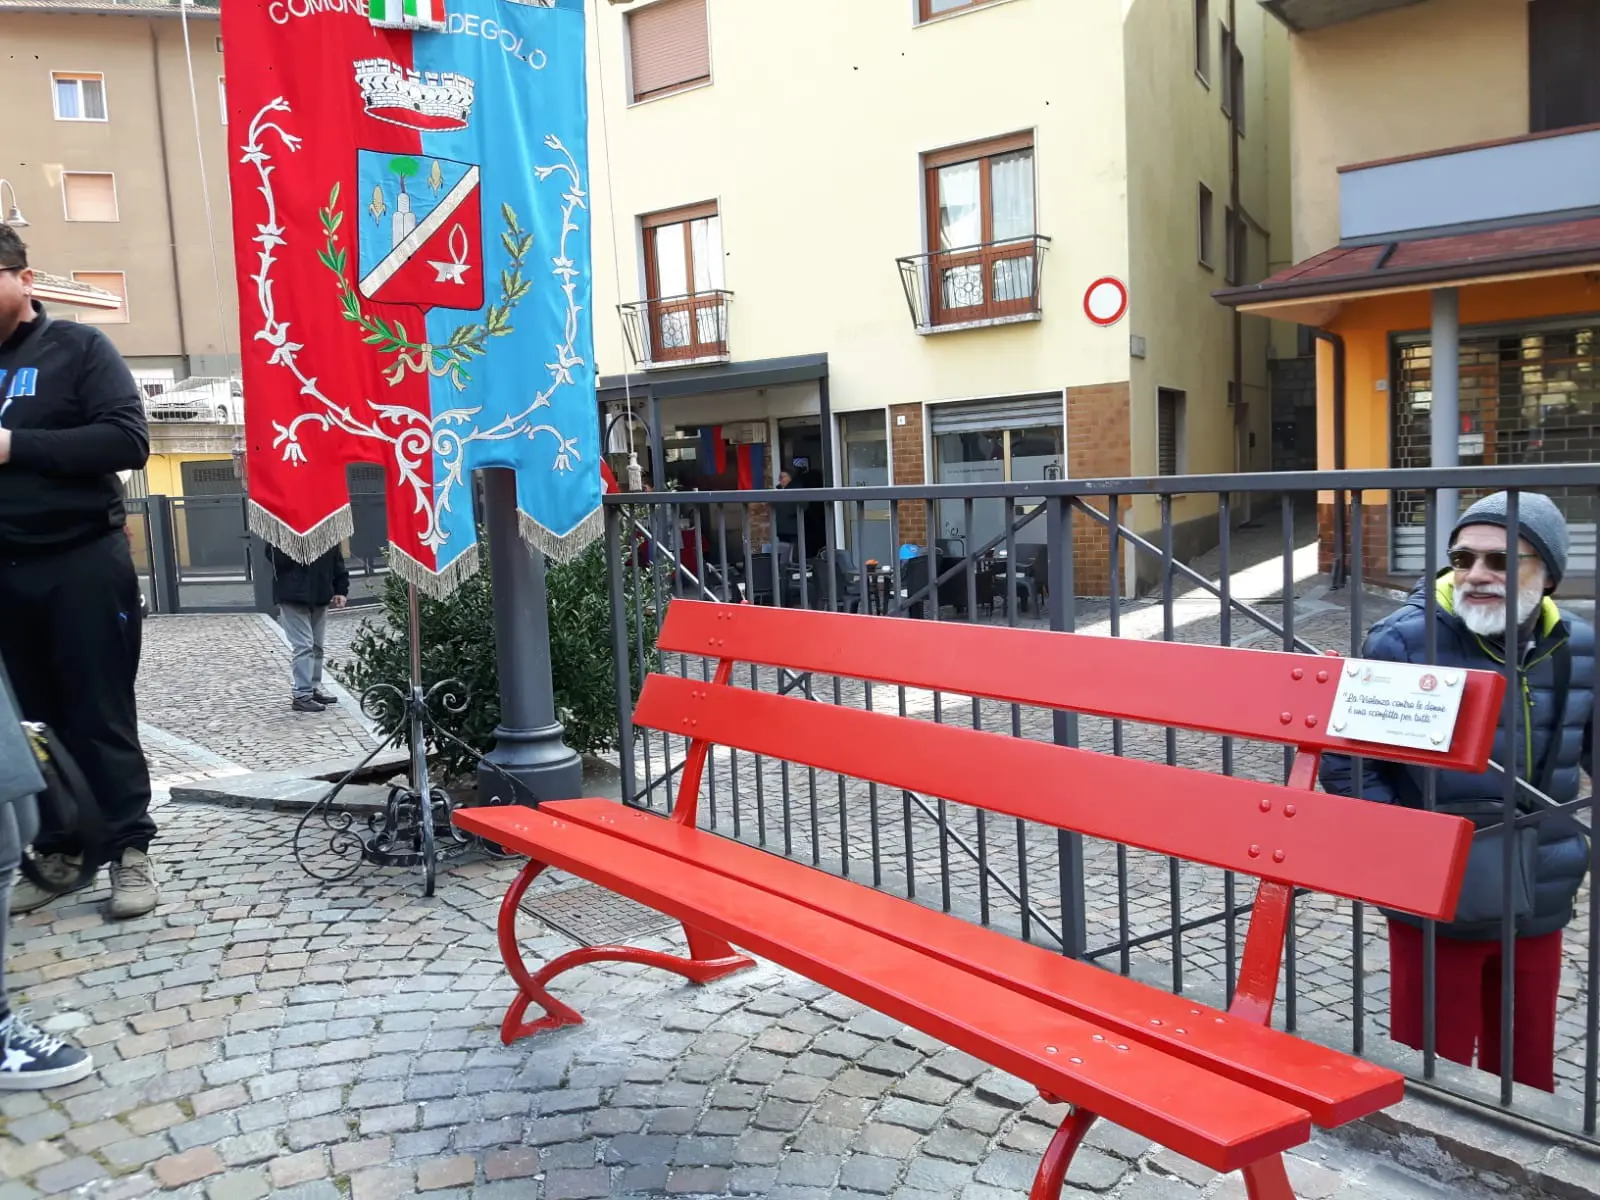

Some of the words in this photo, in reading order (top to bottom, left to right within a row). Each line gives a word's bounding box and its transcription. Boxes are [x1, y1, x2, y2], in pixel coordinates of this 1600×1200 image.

[421, 13, 546, 69] DEGOLO
[1416, 700, 1423, 710] le
[1353, 708, 1366, 716] una
[1400, 712, 1412, 722] per
